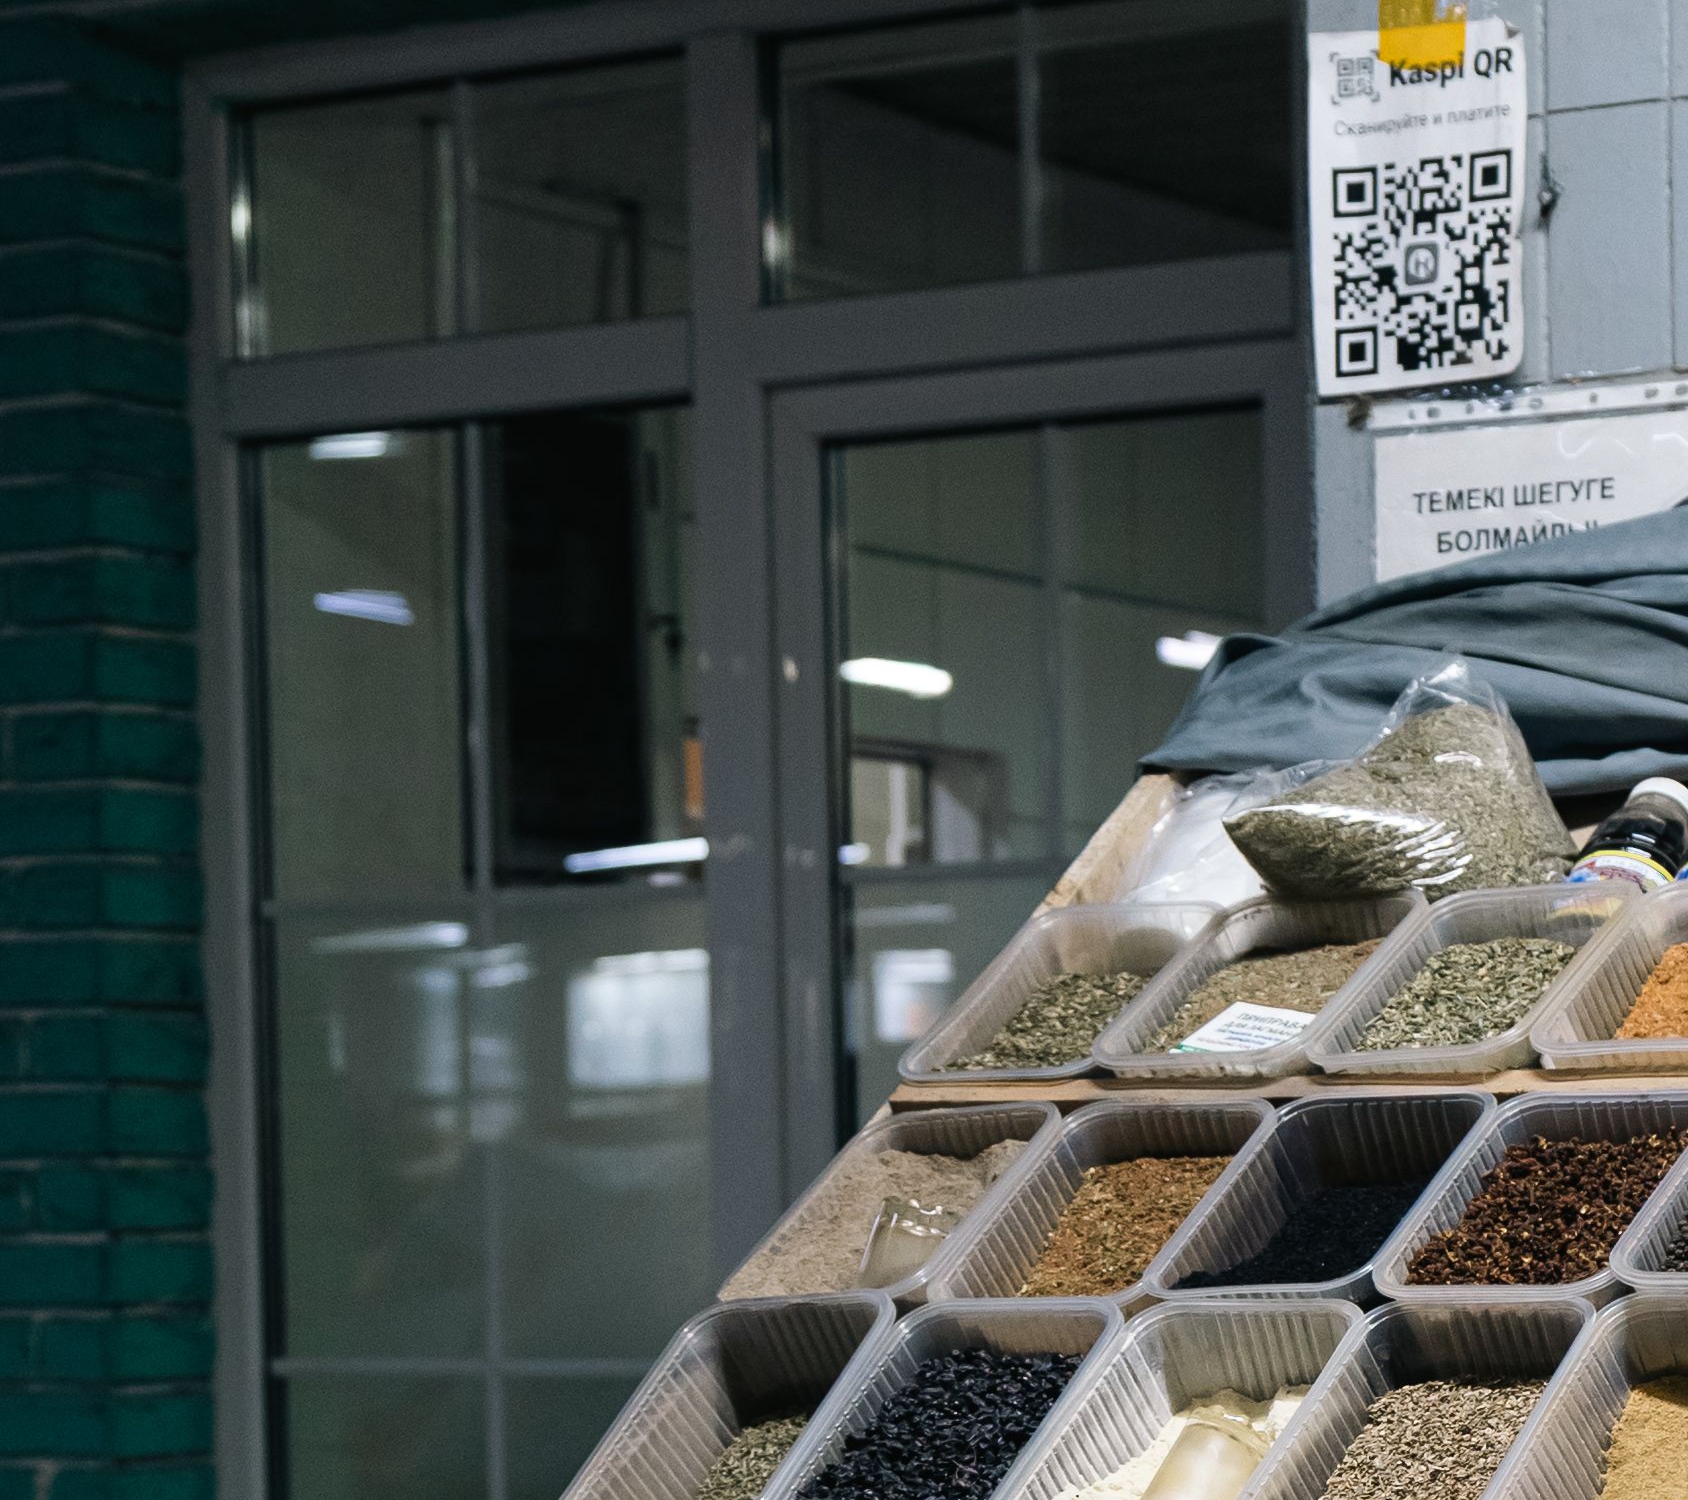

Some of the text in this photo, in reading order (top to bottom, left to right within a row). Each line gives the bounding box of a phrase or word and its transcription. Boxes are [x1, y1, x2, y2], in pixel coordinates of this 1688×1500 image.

[1390, 47, 1512, 87] Kaspi QR
[1334, 104, 1511, 136] Сканируйте и платите
[1514, 477, 1615, 507] ШЕГУГЕ
